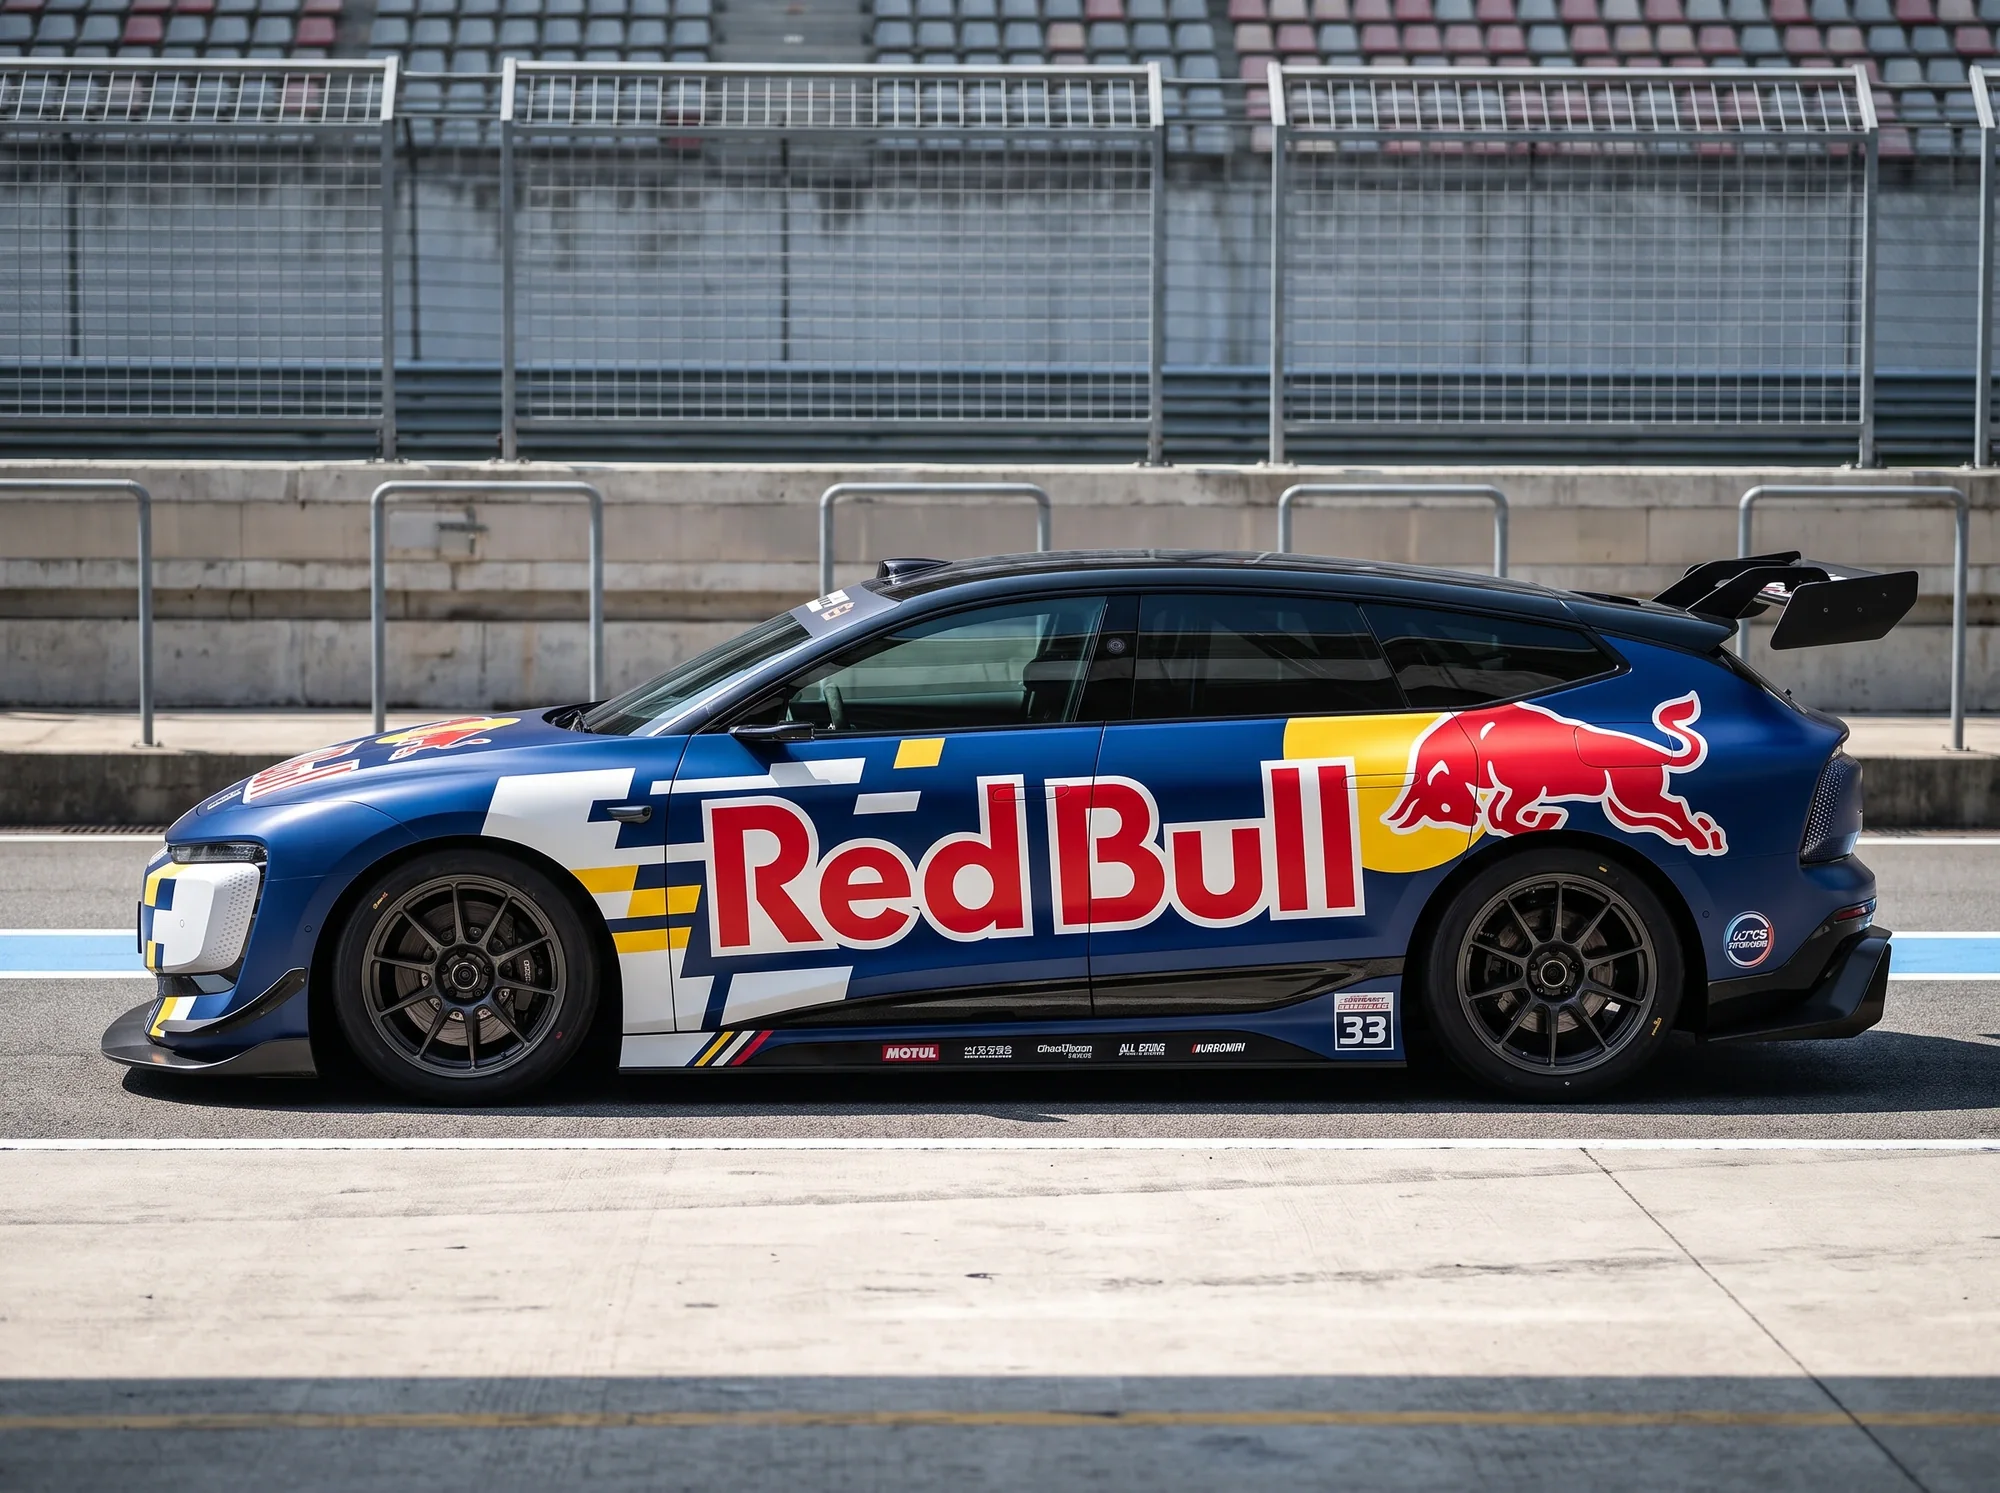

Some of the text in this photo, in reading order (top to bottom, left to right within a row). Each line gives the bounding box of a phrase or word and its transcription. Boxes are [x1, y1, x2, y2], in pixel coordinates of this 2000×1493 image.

[702, 757, 1366, 957] Red Bull
[1340, 1016, 1387, 1045] 33
[885, 1047, 936, 1059] MOTUL
